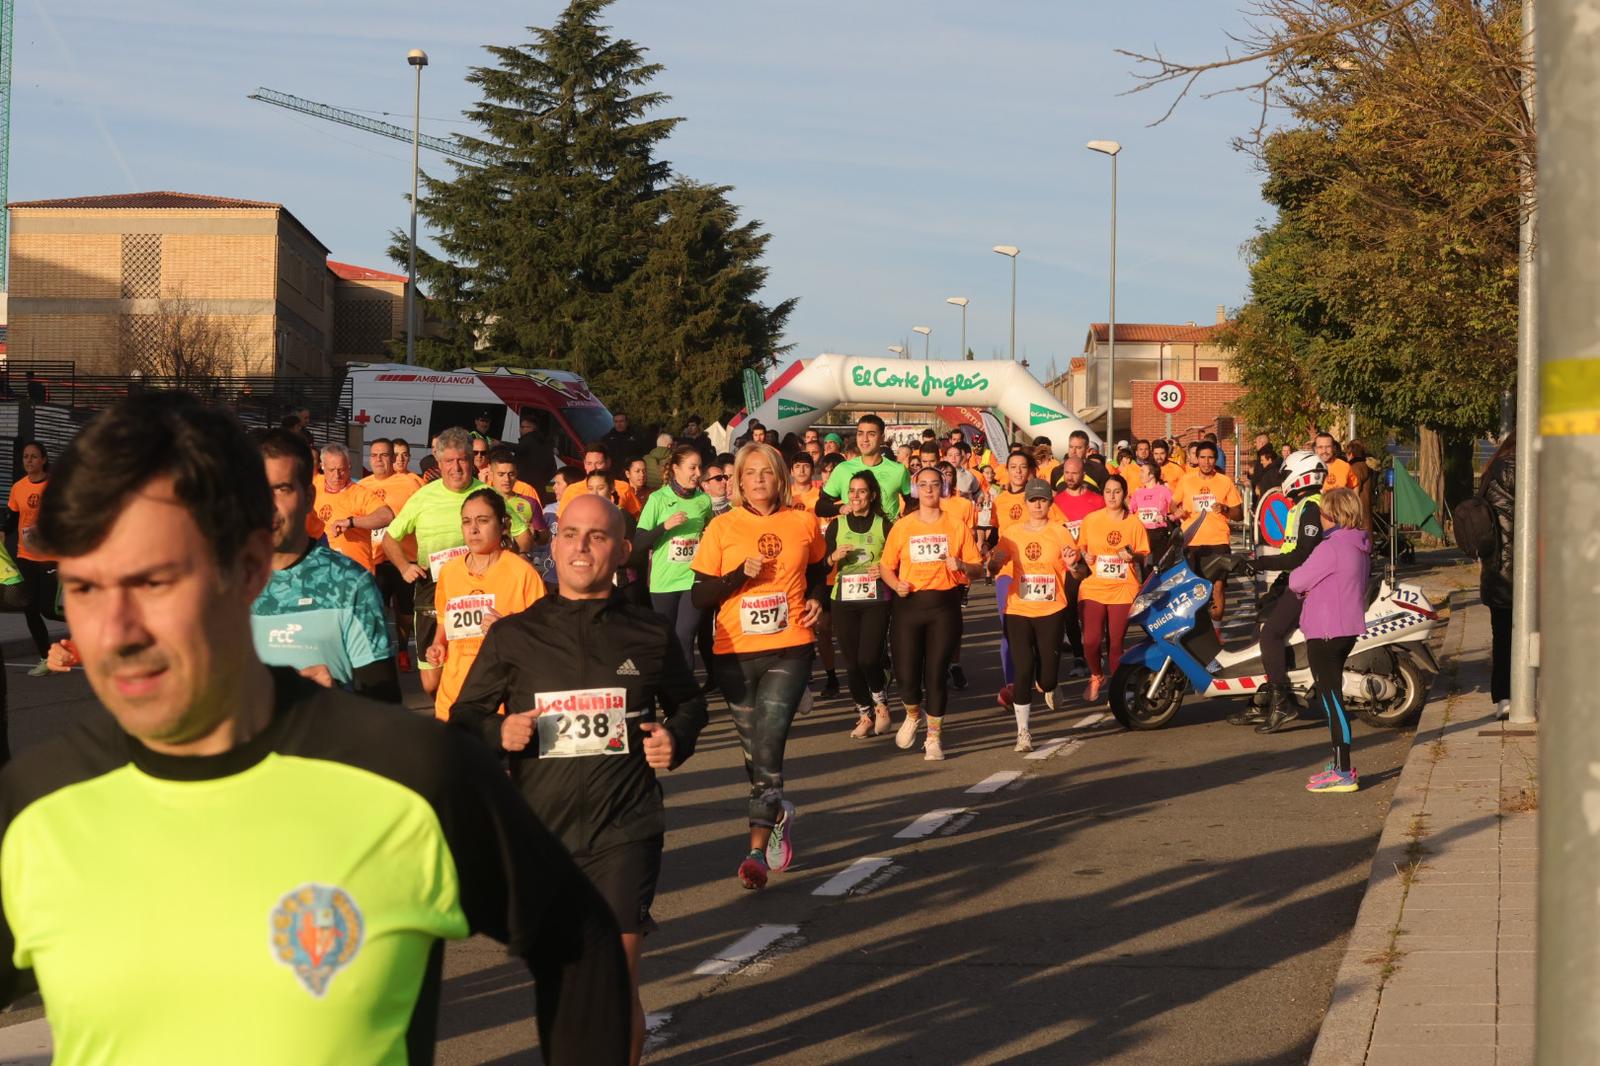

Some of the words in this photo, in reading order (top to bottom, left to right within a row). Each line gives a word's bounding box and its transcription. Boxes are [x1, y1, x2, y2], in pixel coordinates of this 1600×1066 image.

[415, 376, 475, 385] AMBULANCIA
[852, 365, 872, 386] El
[873, 367, 919, 388] Corte
[921, 365, 989, 397] Inglés
[1160, 391, 1178, 402] 30
[374, 414, 397, 425] Cruz
[400, 415, 422, 426] Roja
[675, 546, 694, 556] 303
[918, 543, 940, 555] 313
[1103, 563, 1121, 573] 251
[848, 583, 869, 594] 275
[1026, 584, 1047, 594] 141
[741, 595, 786, 609] bedunia
[1166, 592, 1189, 611] 112
[1395, 588, 1419, 605] 112
[453, 610, 482, 629] 200
[750, 608, 779, 625] 257
[537, 693, 624, 713] bedunia
[556, 713, 609, 739] 238
